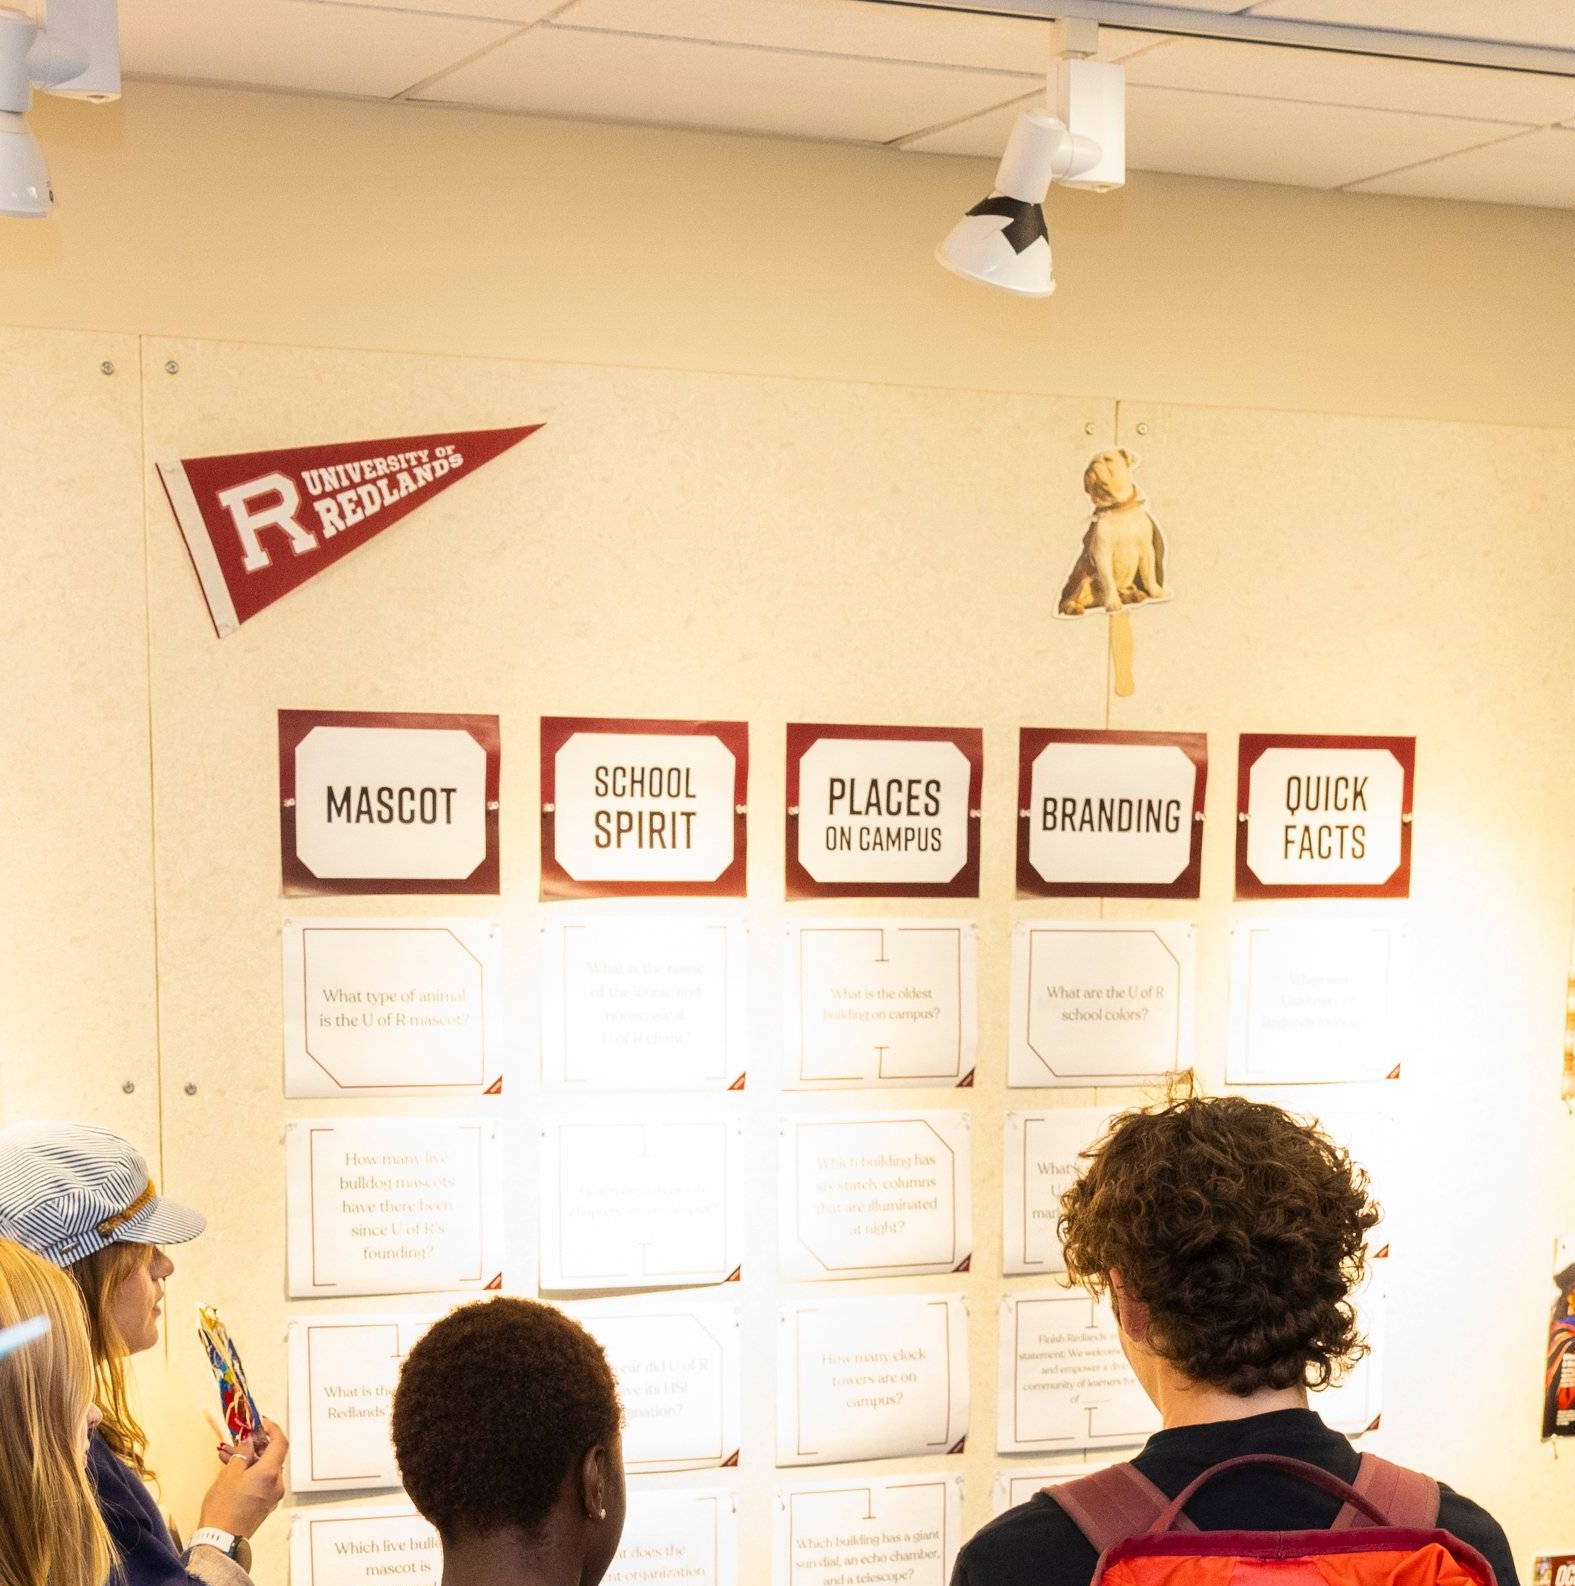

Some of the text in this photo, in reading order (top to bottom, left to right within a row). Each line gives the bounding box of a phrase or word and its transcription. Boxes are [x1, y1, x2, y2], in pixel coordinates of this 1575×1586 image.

[302, 445, 456, 496] UNIVERSITY OF
[313, 453, 464, 539] REDLANDS
[218, 472, 318, 572] R
[595, 766, 696, 799] SCHOOL
[828, 777, 941, 817] PLACES
[1286, 776, 1368, 816] QUICK
[326, 786, 457, 825] MASCOT
[1041, 797, 1181, 834] BRANDING
[595, 810, 697, 849] SPIRIT
[825, 826, 942, 852] ON CAMPUS
[1284, 825, 1366, 860] FACTS
[323, 988, 416, 1006] What type of
[831, 987, 933, 1000] What the oldest
[1047, 985, 1164, 999] What are the U of R
[320, 1013, 391, 1027] is the U of
[889, 1007, 940, 1023] campus?
[1062, 1008, 1148, 1021] school colors?
[346, 1152, 377, 1166] How
[915, 1153, 936, 1166] has
[340, 1176, 392, 1191] bulldog
[343, 1200, 376, 1213] have
[352, 1224, 388, 1237] since
[893, 1348, 926, 1361] clock
[325, 1385, 372, 1398] What is
[1023, 1379, 1074, 1392] community
[335, 1538, 406, 1555] Which live
[796, 1530, 939, 1549] Which building has giant
[844, 1549, 941, 1566] an echo chamber,
[366, 1560, 431, 1576] mascot is
[824, 1569, 914, 1586] and telescope?
